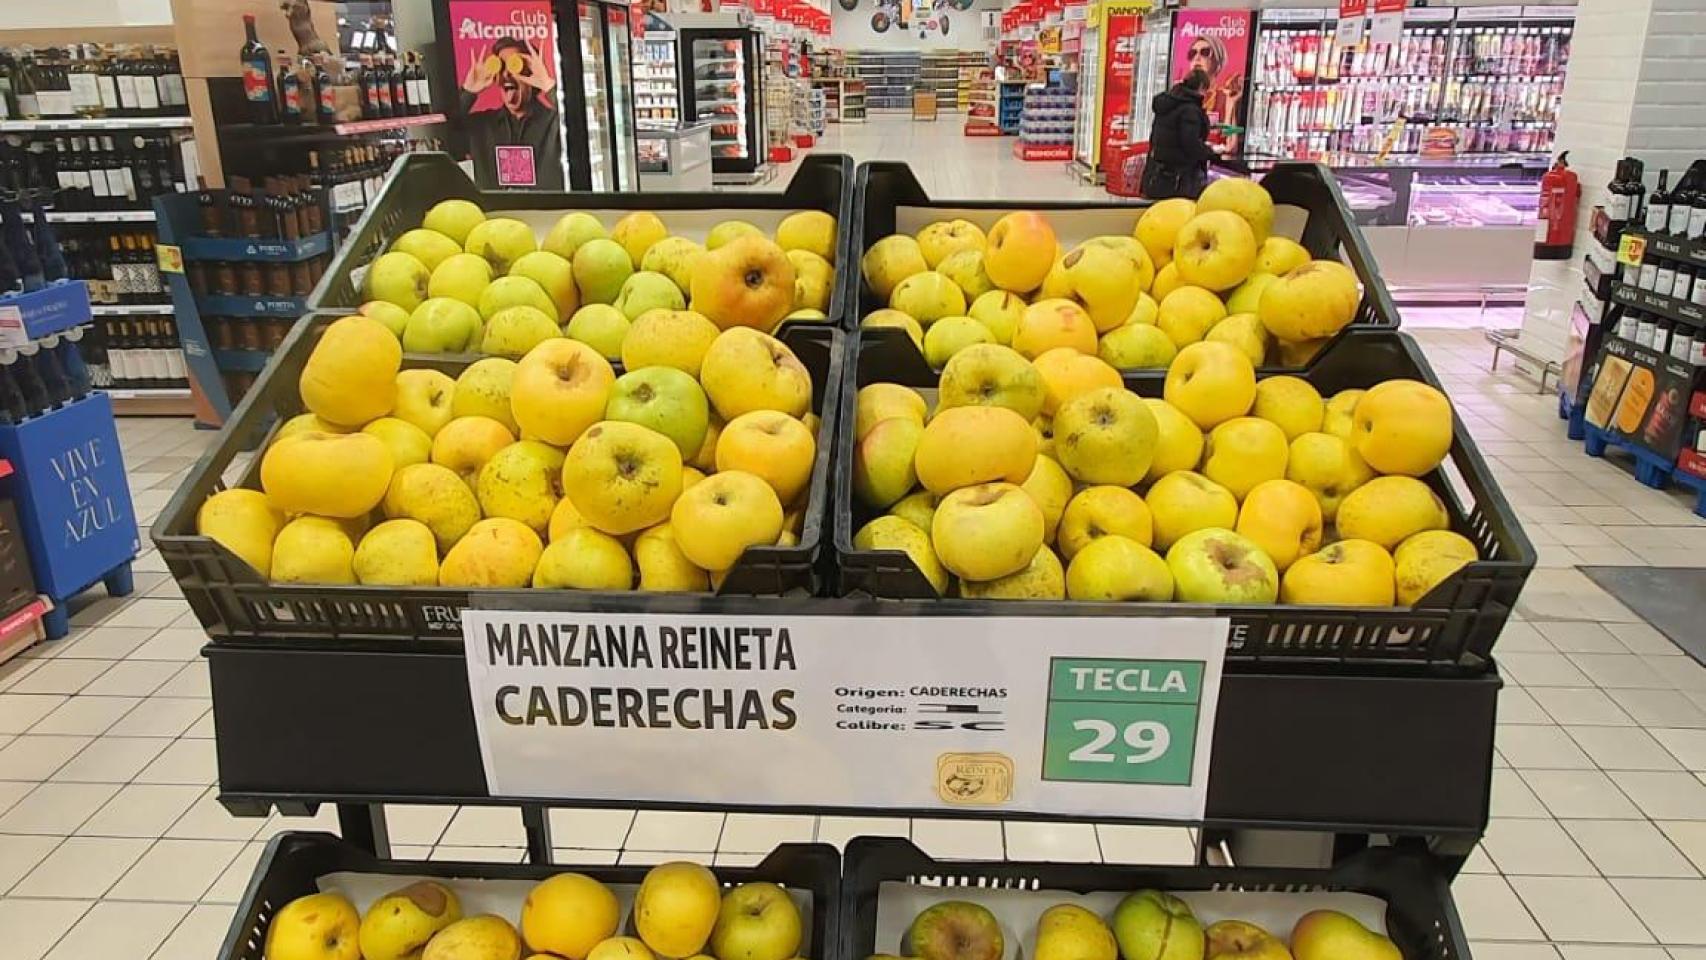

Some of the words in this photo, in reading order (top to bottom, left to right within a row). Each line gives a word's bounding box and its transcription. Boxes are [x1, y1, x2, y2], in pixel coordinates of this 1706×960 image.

[459, 18, 549, 40] Alcampo
[510, 9, 548, 25] Club
[1220, 16, 1246, 28] Club
[1181, 21, 1246, 39] Alcampo
[51, 438, 106, 481] VIVE
[71, 476, 100, 510] EN
[65, 497, 121, 547] AZUL
[422, 605, 463, 622] FRU
[486, 622, 654, 669] MANZANA
[659, 626, 797, 671] REINETA
[1069, 667, 1187, 693] TECLA
[834, 686, 906, 700] Origen:
[909, 686, 1008, 698] CADERECHAS
[495, 685, 797, 730] CADERECHAS
[835, 720, 906, 731] Calibre:
[1068, 719, 1171, 764] 29
